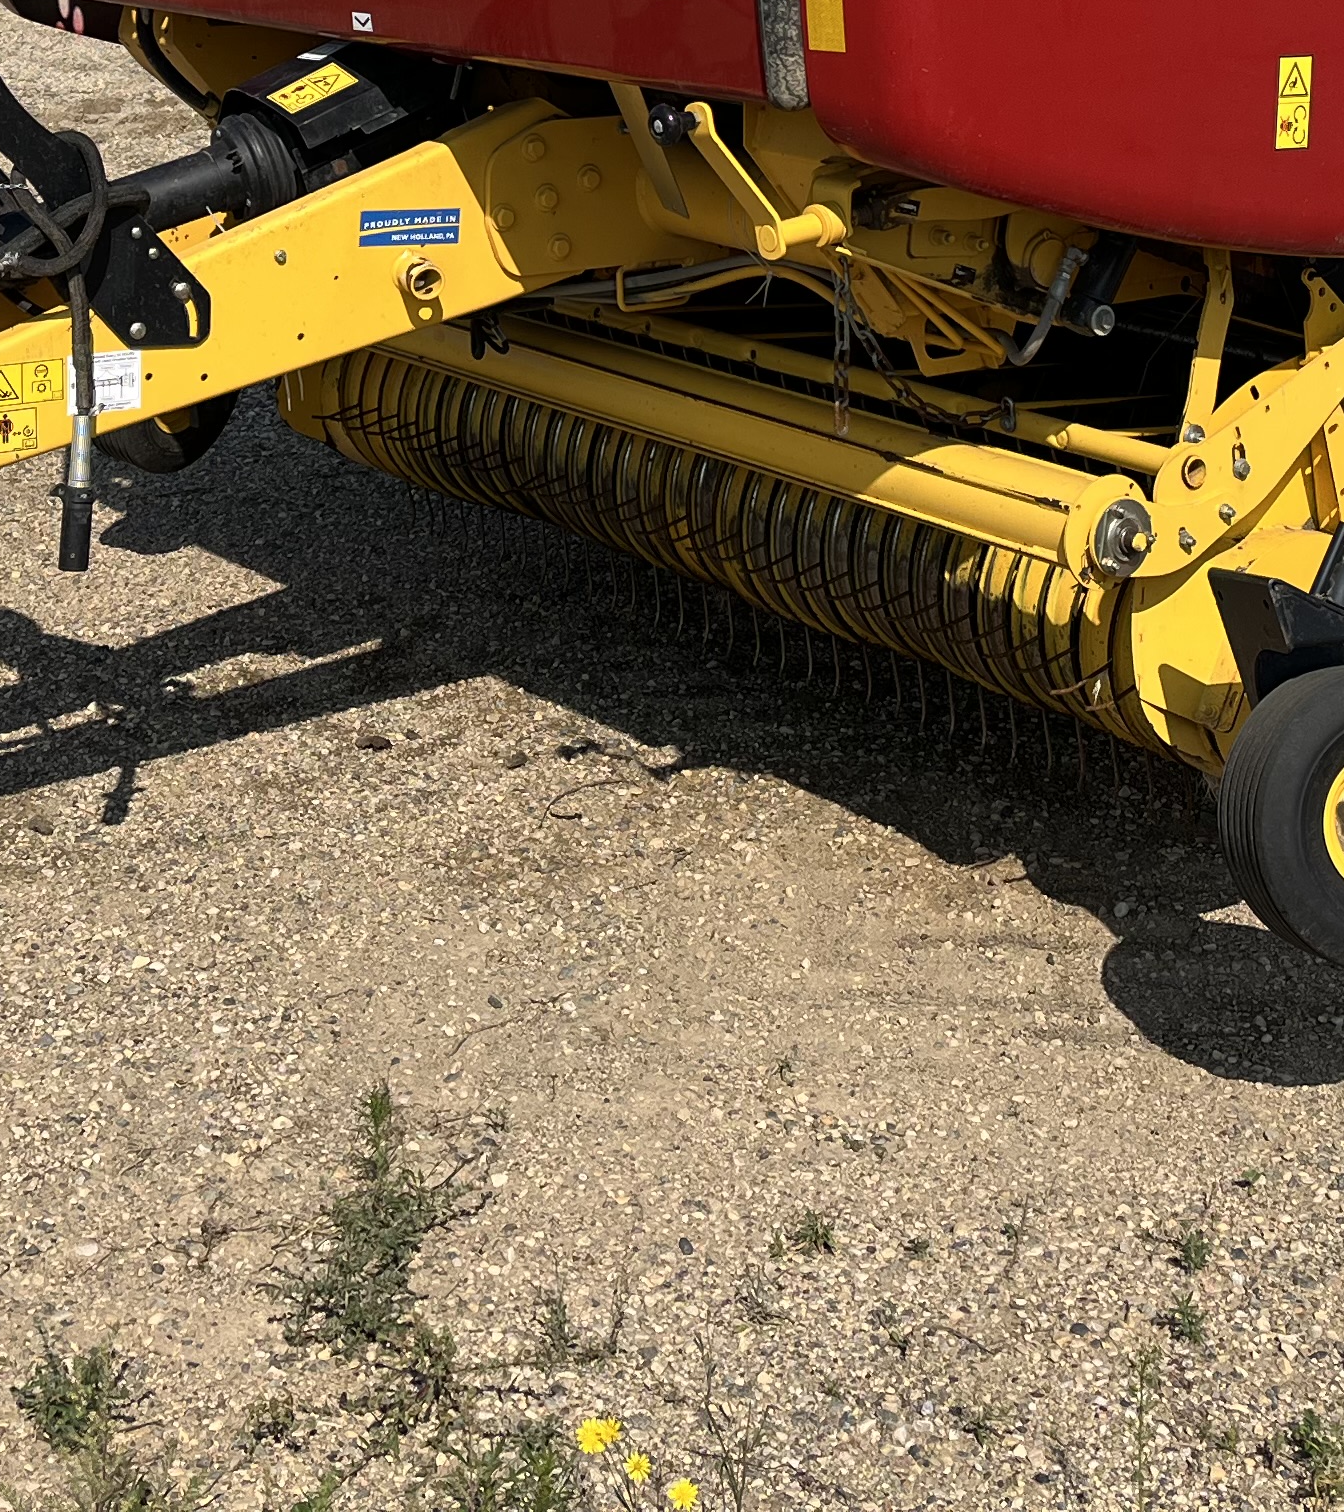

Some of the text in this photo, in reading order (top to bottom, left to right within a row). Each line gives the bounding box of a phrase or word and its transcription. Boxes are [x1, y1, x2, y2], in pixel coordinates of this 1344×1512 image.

[363, 215, 457, 230] PROUDLY MADE IN
